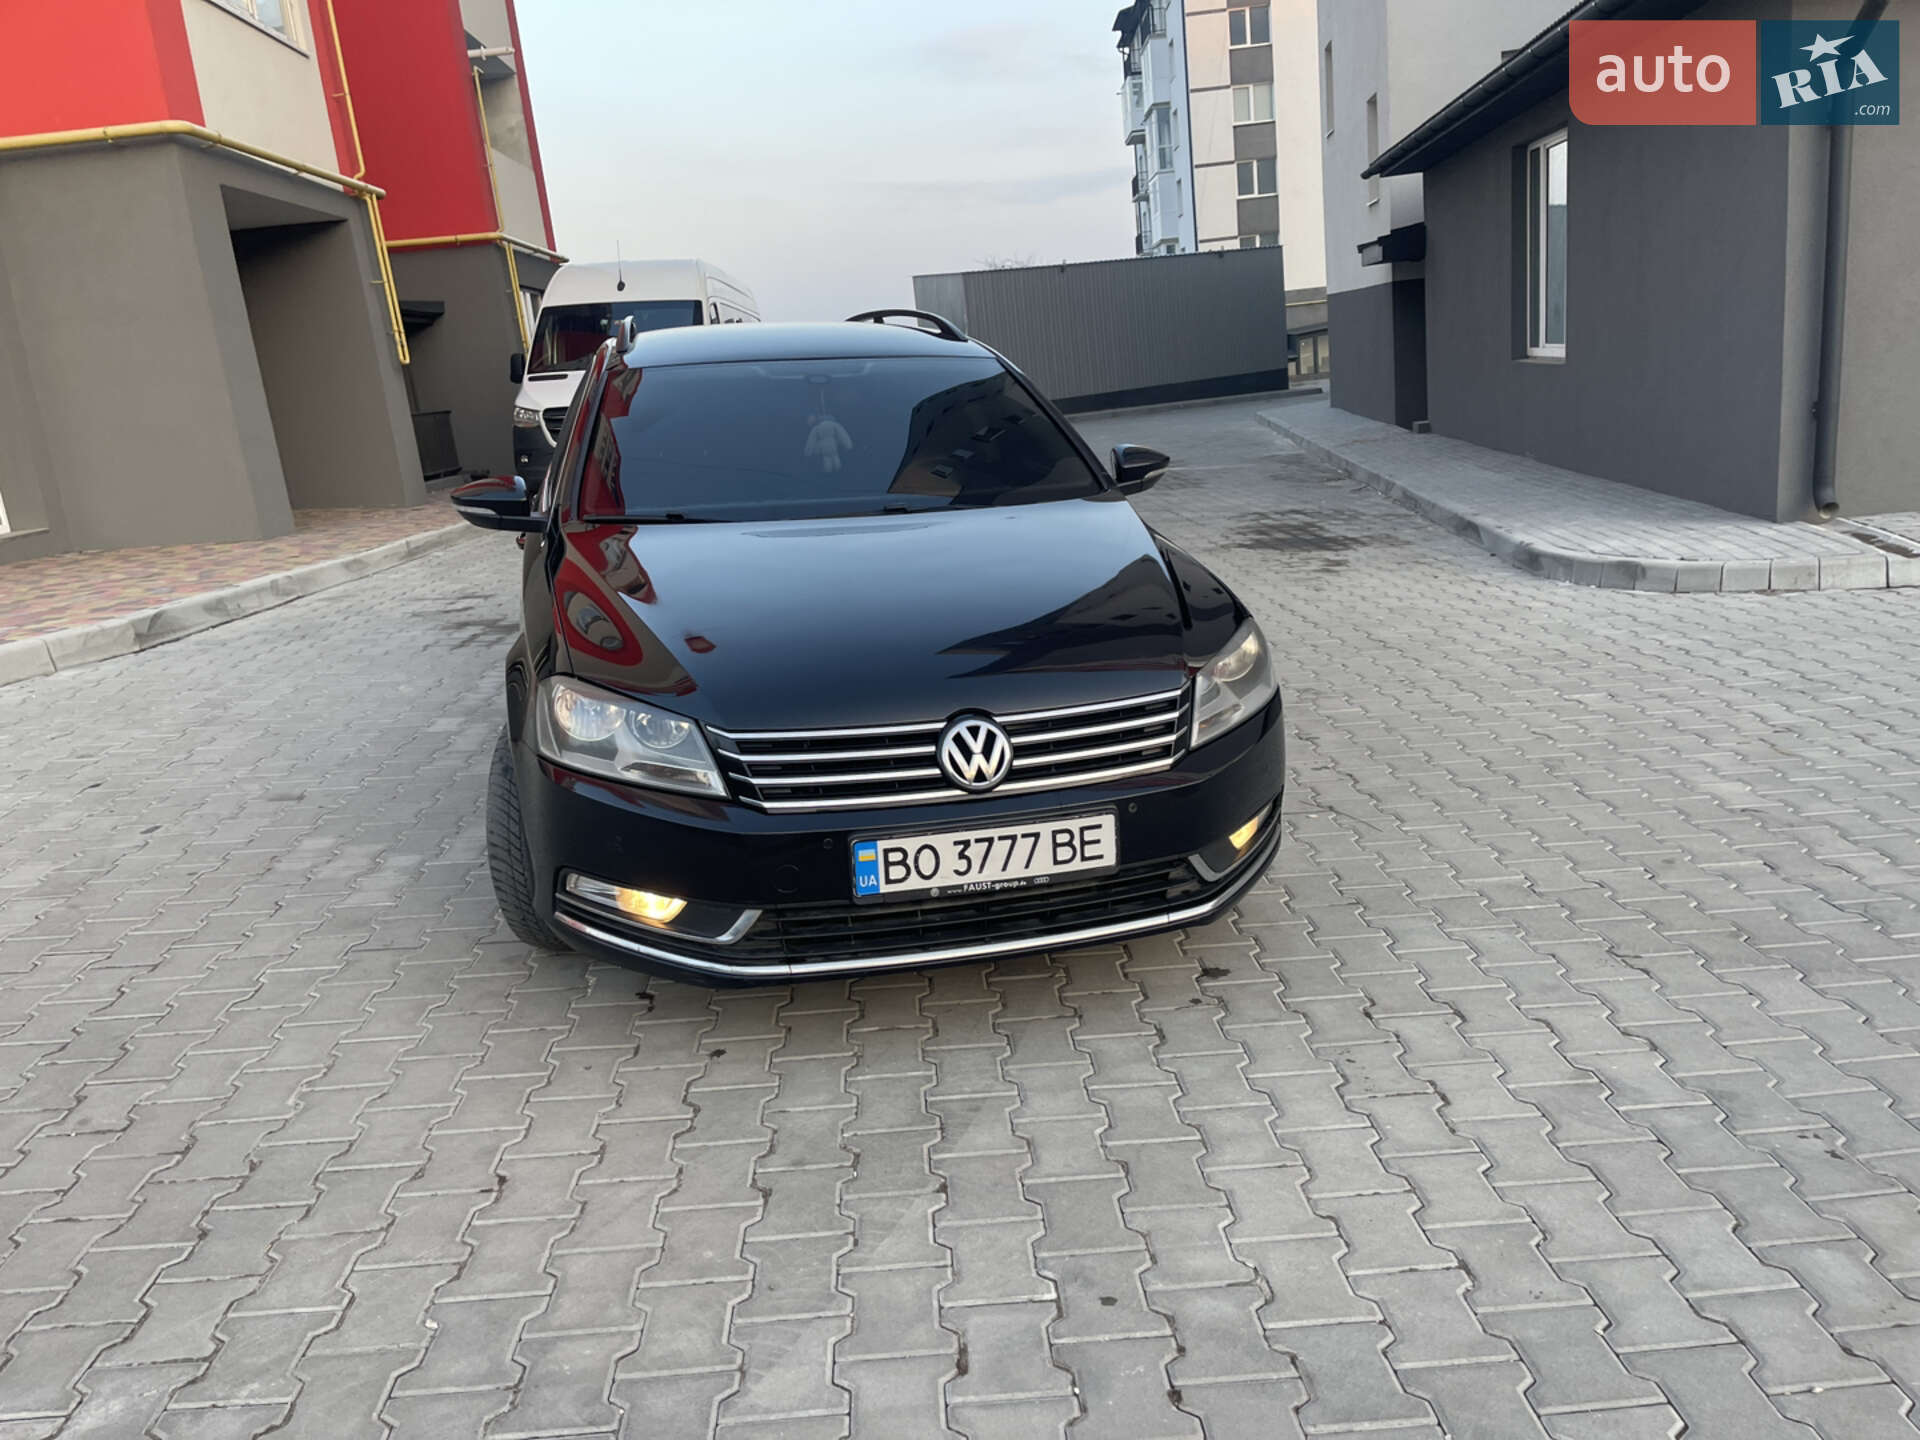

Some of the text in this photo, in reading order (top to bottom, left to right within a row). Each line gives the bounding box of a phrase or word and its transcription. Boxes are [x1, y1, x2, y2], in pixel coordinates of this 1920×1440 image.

[882, 823, 1104, 885] BO 3777 BE
[859, 875, 878, 887] UA
